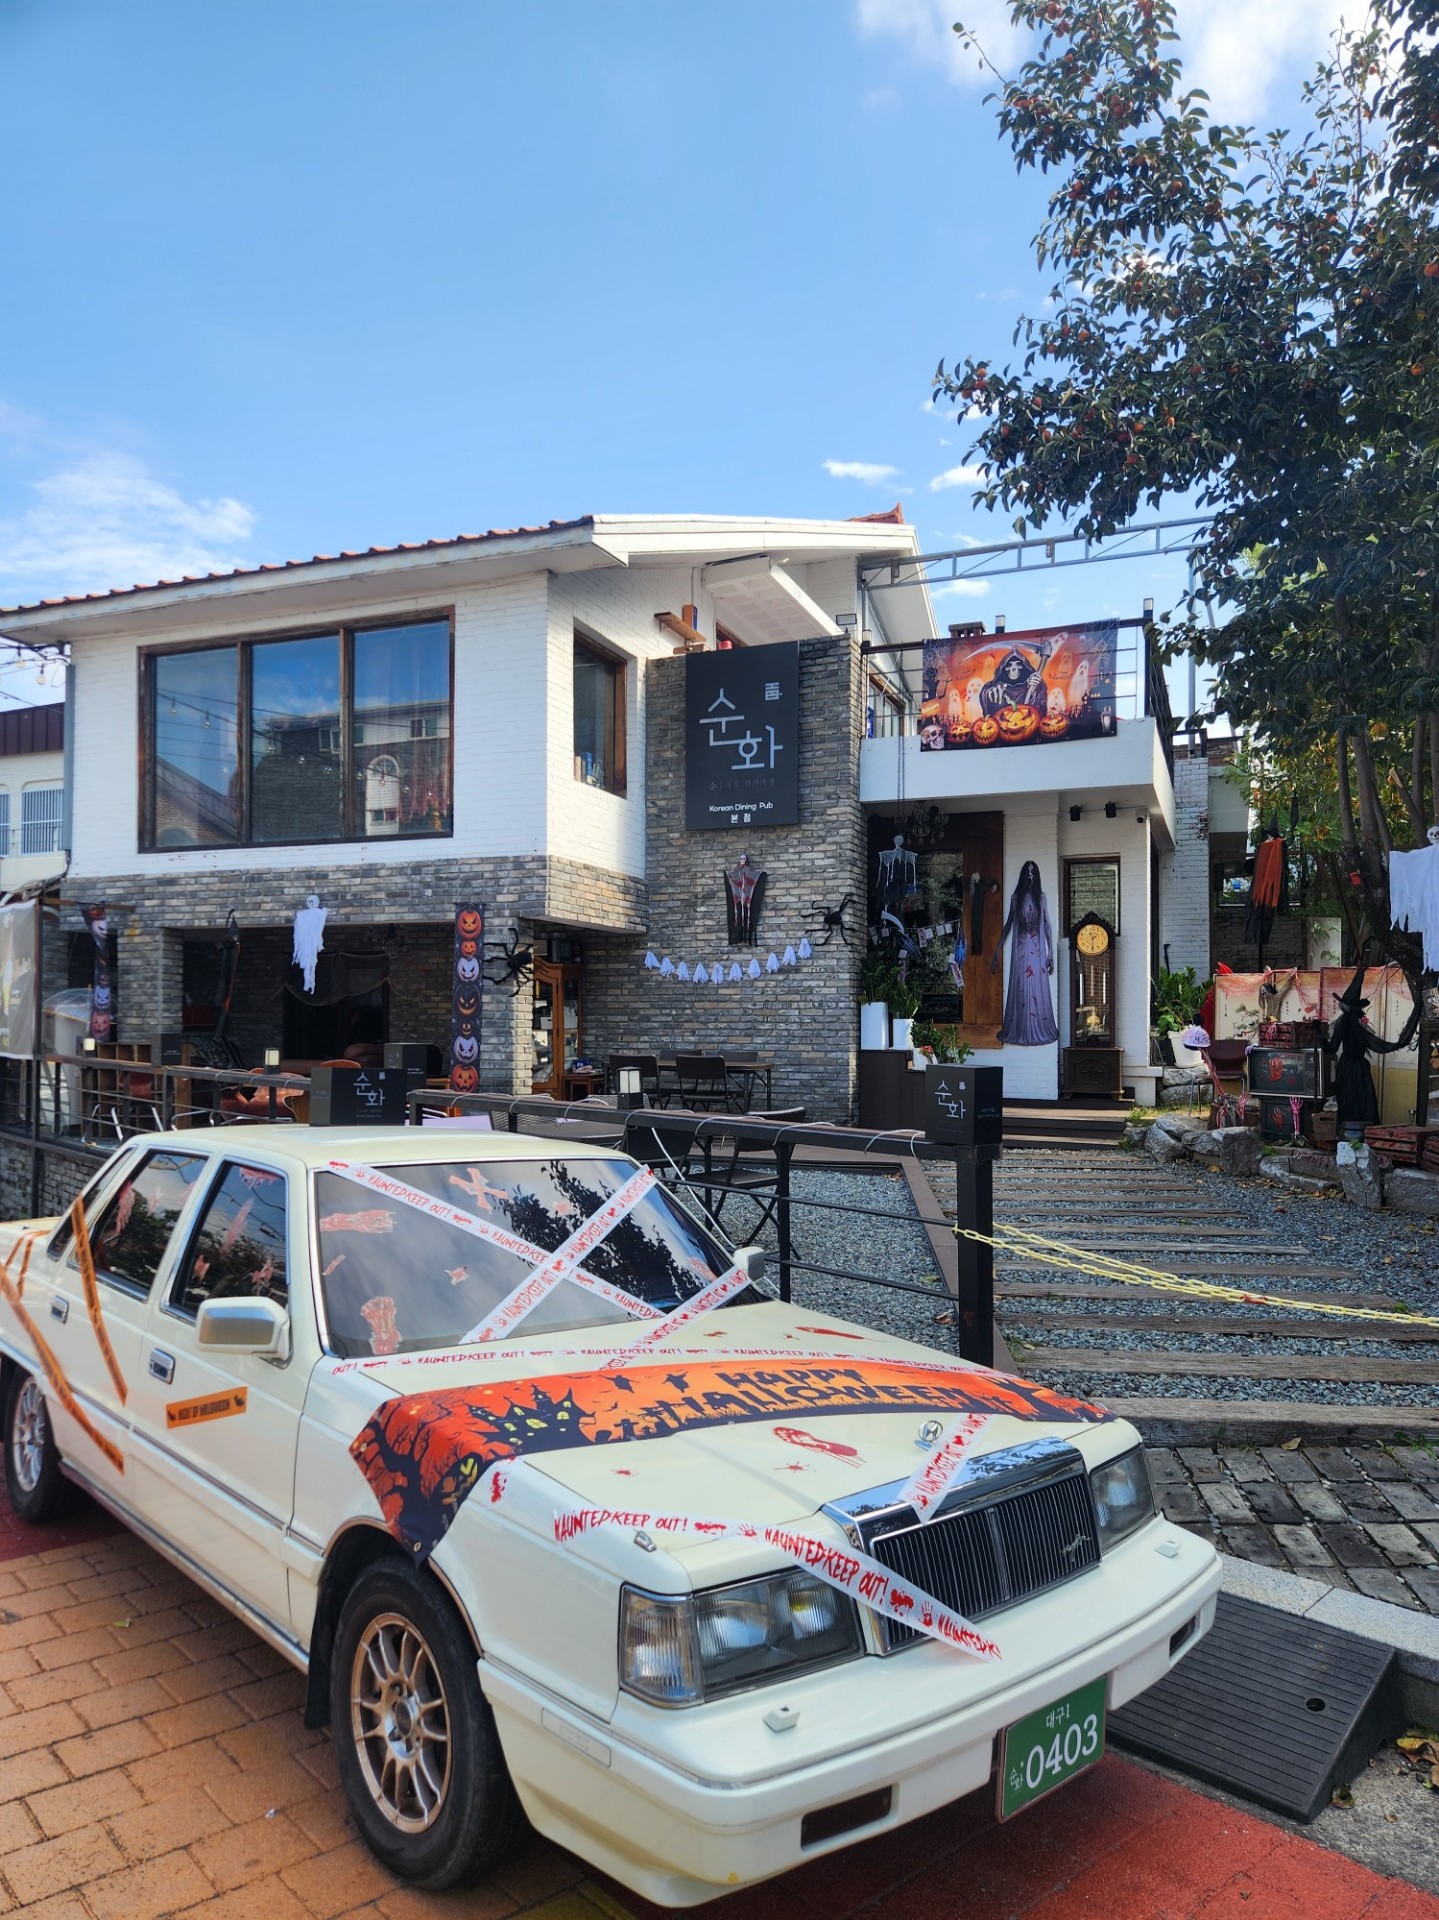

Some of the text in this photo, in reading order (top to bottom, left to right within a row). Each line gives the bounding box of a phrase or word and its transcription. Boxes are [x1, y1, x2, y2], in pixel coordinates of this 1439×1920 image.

[699, 687, 784, 770] 순화
[708, 801, 774, 812] Korean Dining Pub
[353, 1071, 386, 1106] 순화
[934, 1080, 967, 1119] 순화
[429, 1202, 452, 1218] OUT!
[331, 1362, 358, 1376] OUT!
[501, 1350, 525, 1358] OUT!
[714, 1369, 869, 1391] HAPPY
[656, 1384, 980, 1426] HALLOWEEN
[655, 1516, 689, 1532] OUT!
[858, 1569, 890, 1605] OUT!
[1025, 1713, 1099, 1790] 0403
